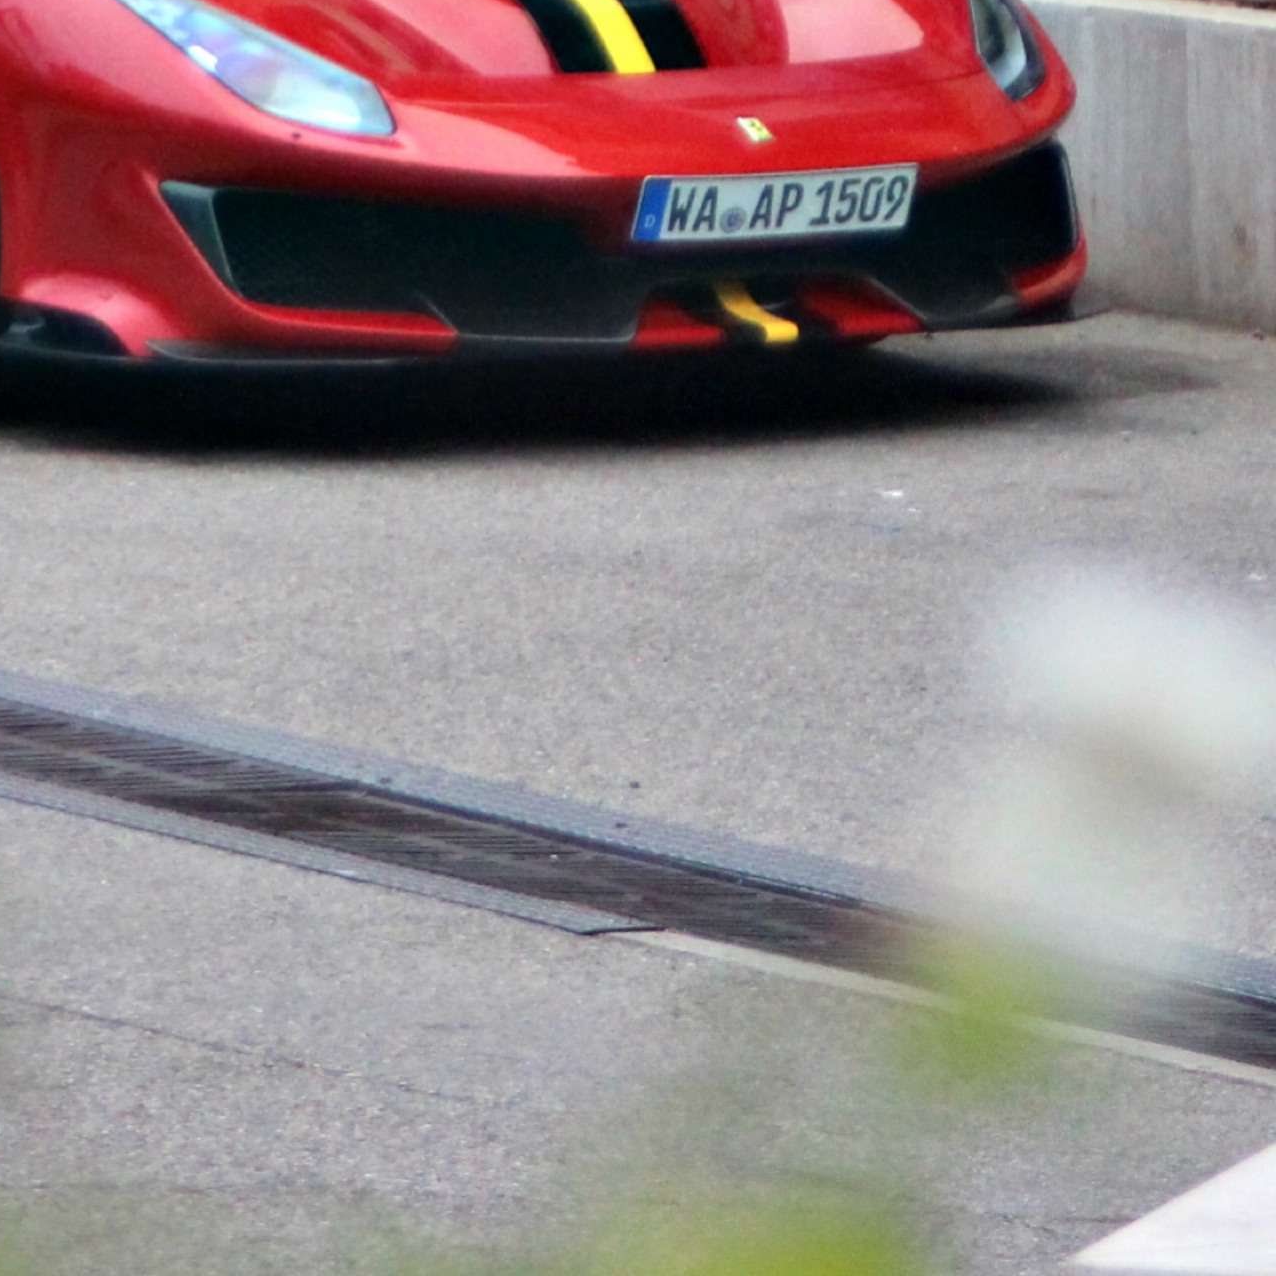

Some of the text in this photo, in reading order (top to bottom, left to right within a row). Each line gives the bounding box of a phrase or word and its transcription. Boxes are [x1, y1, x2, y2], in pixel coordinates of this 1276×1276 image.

[667, 176, 910, 232] WA AP 1509
